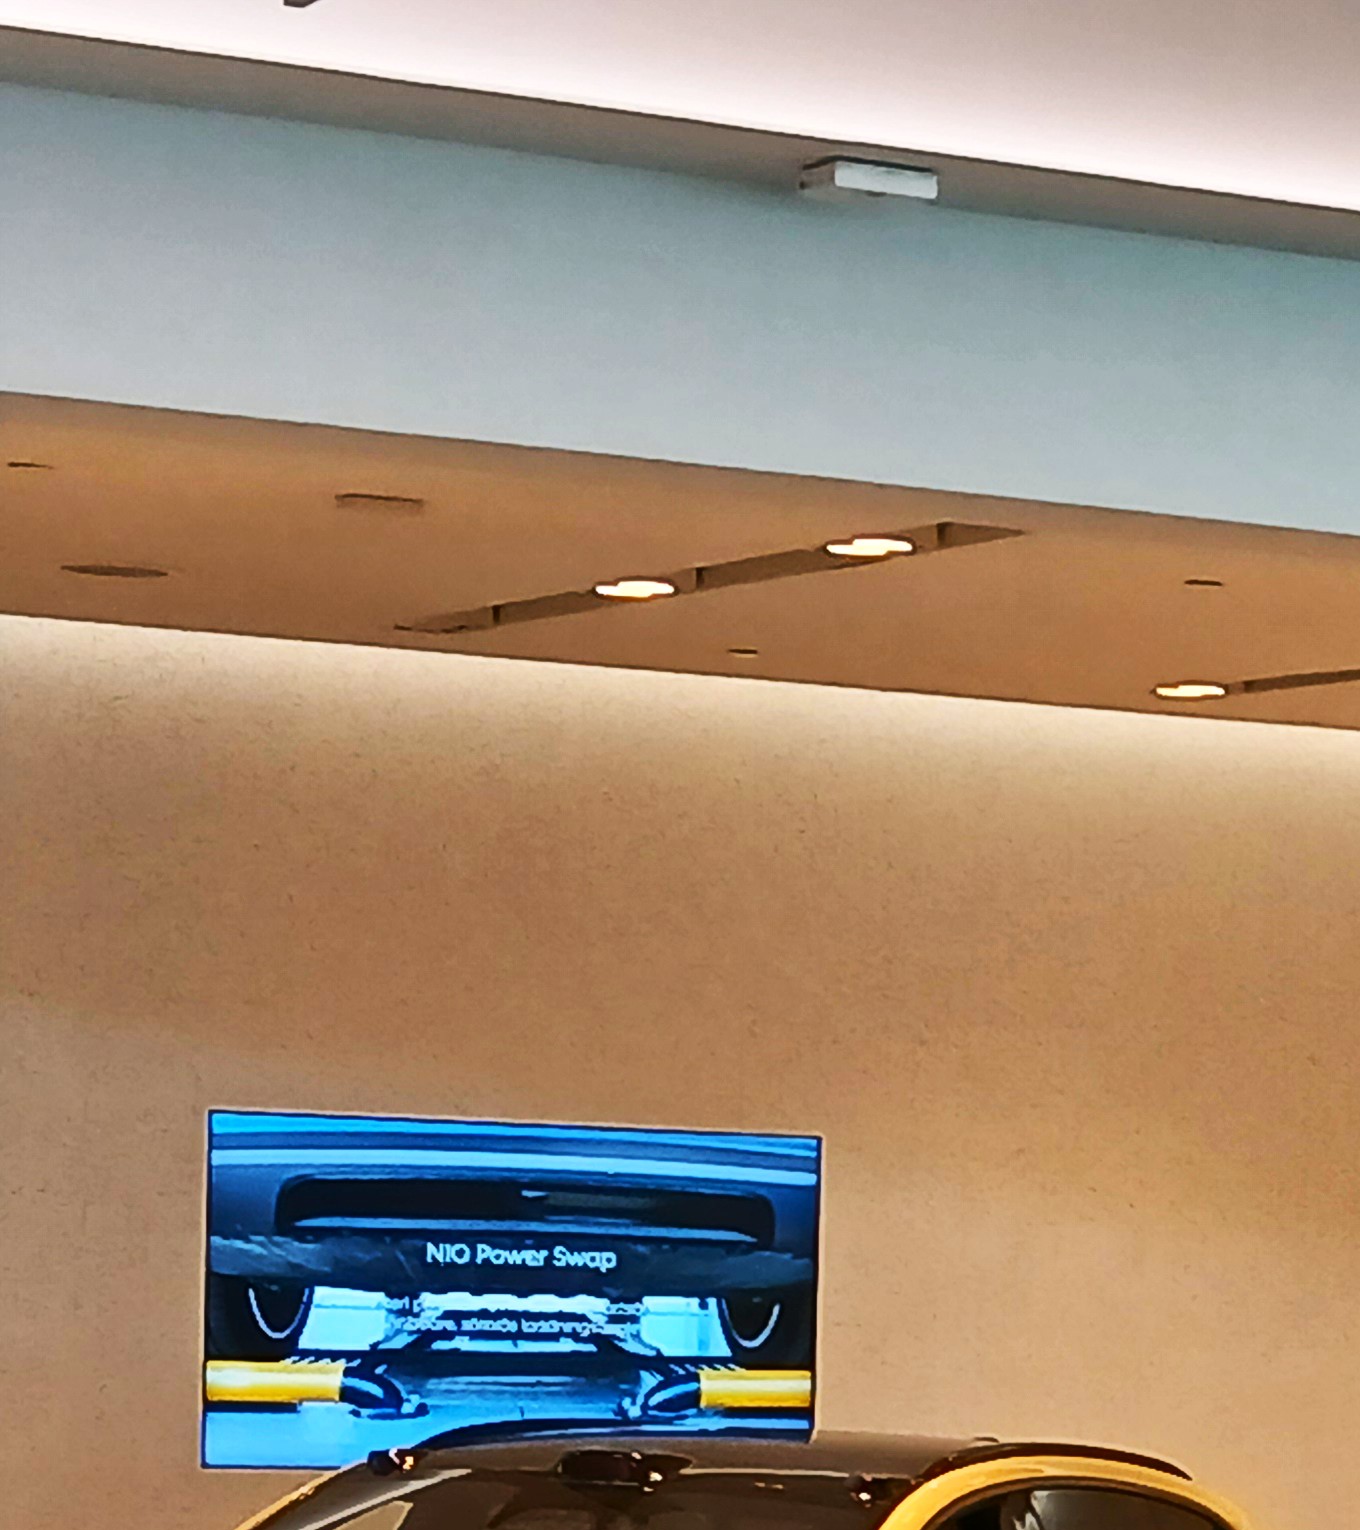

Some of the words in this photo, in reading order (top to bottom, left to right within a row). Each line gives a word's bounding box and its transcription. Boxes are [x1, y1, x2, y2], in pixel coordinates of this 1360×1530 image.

[426, 1241, 471, 1265] NIO
[476, 1243, 548, 1267] Power
[552, 1245, 617, 1273] Swap
